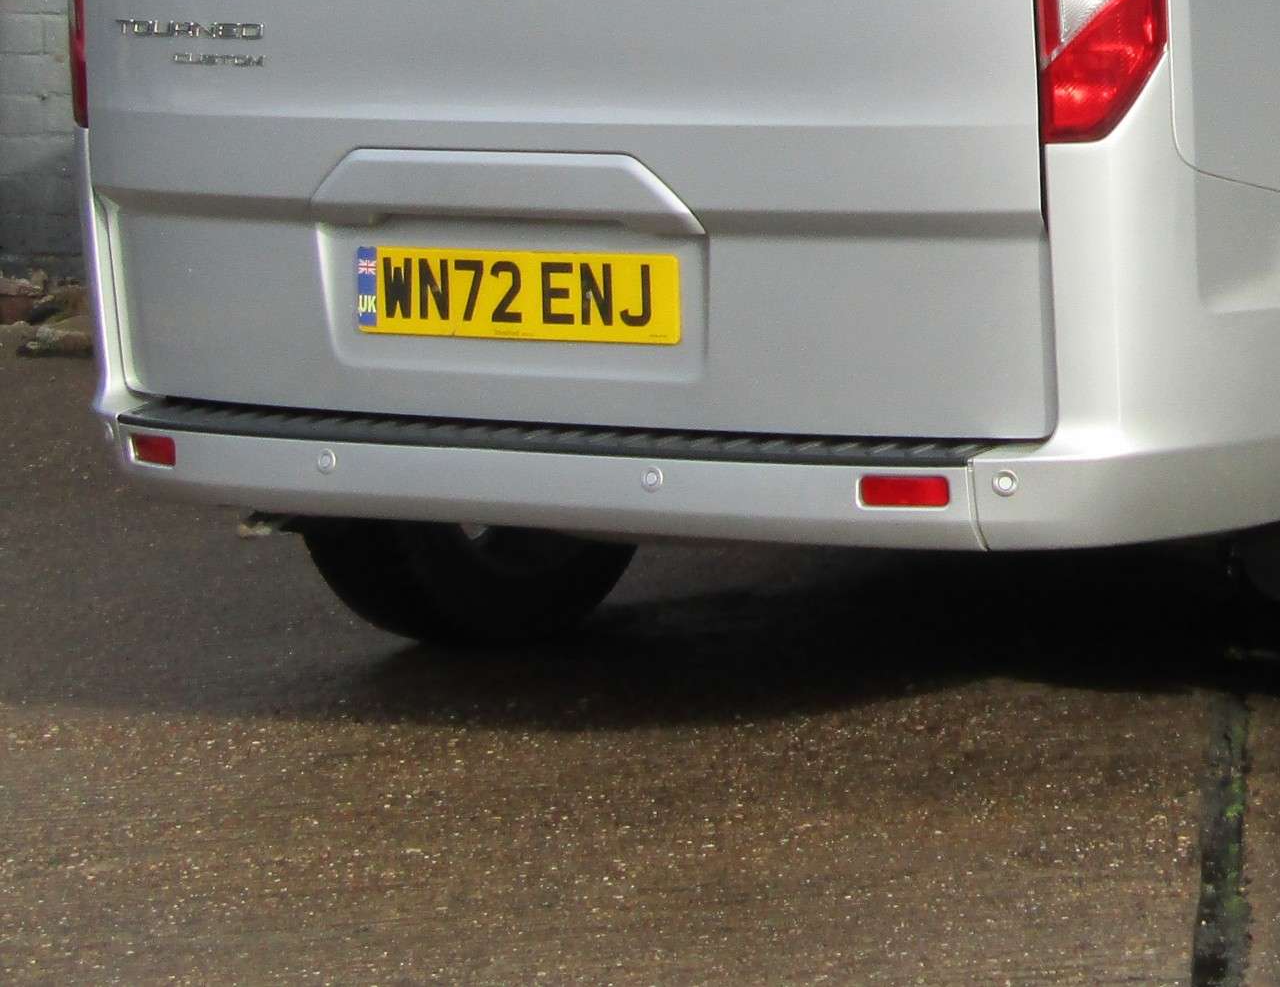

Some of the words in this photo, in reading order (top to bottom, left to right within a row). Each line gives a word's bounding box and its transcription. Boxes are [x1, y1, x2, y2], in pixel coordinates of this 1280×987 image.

[115, 18, 264, 40] TOURNEO
[382, 257, 523, 324] WN72
[540, 261, 653, 327] ENJ
[358, 294, 377, 314] UK
